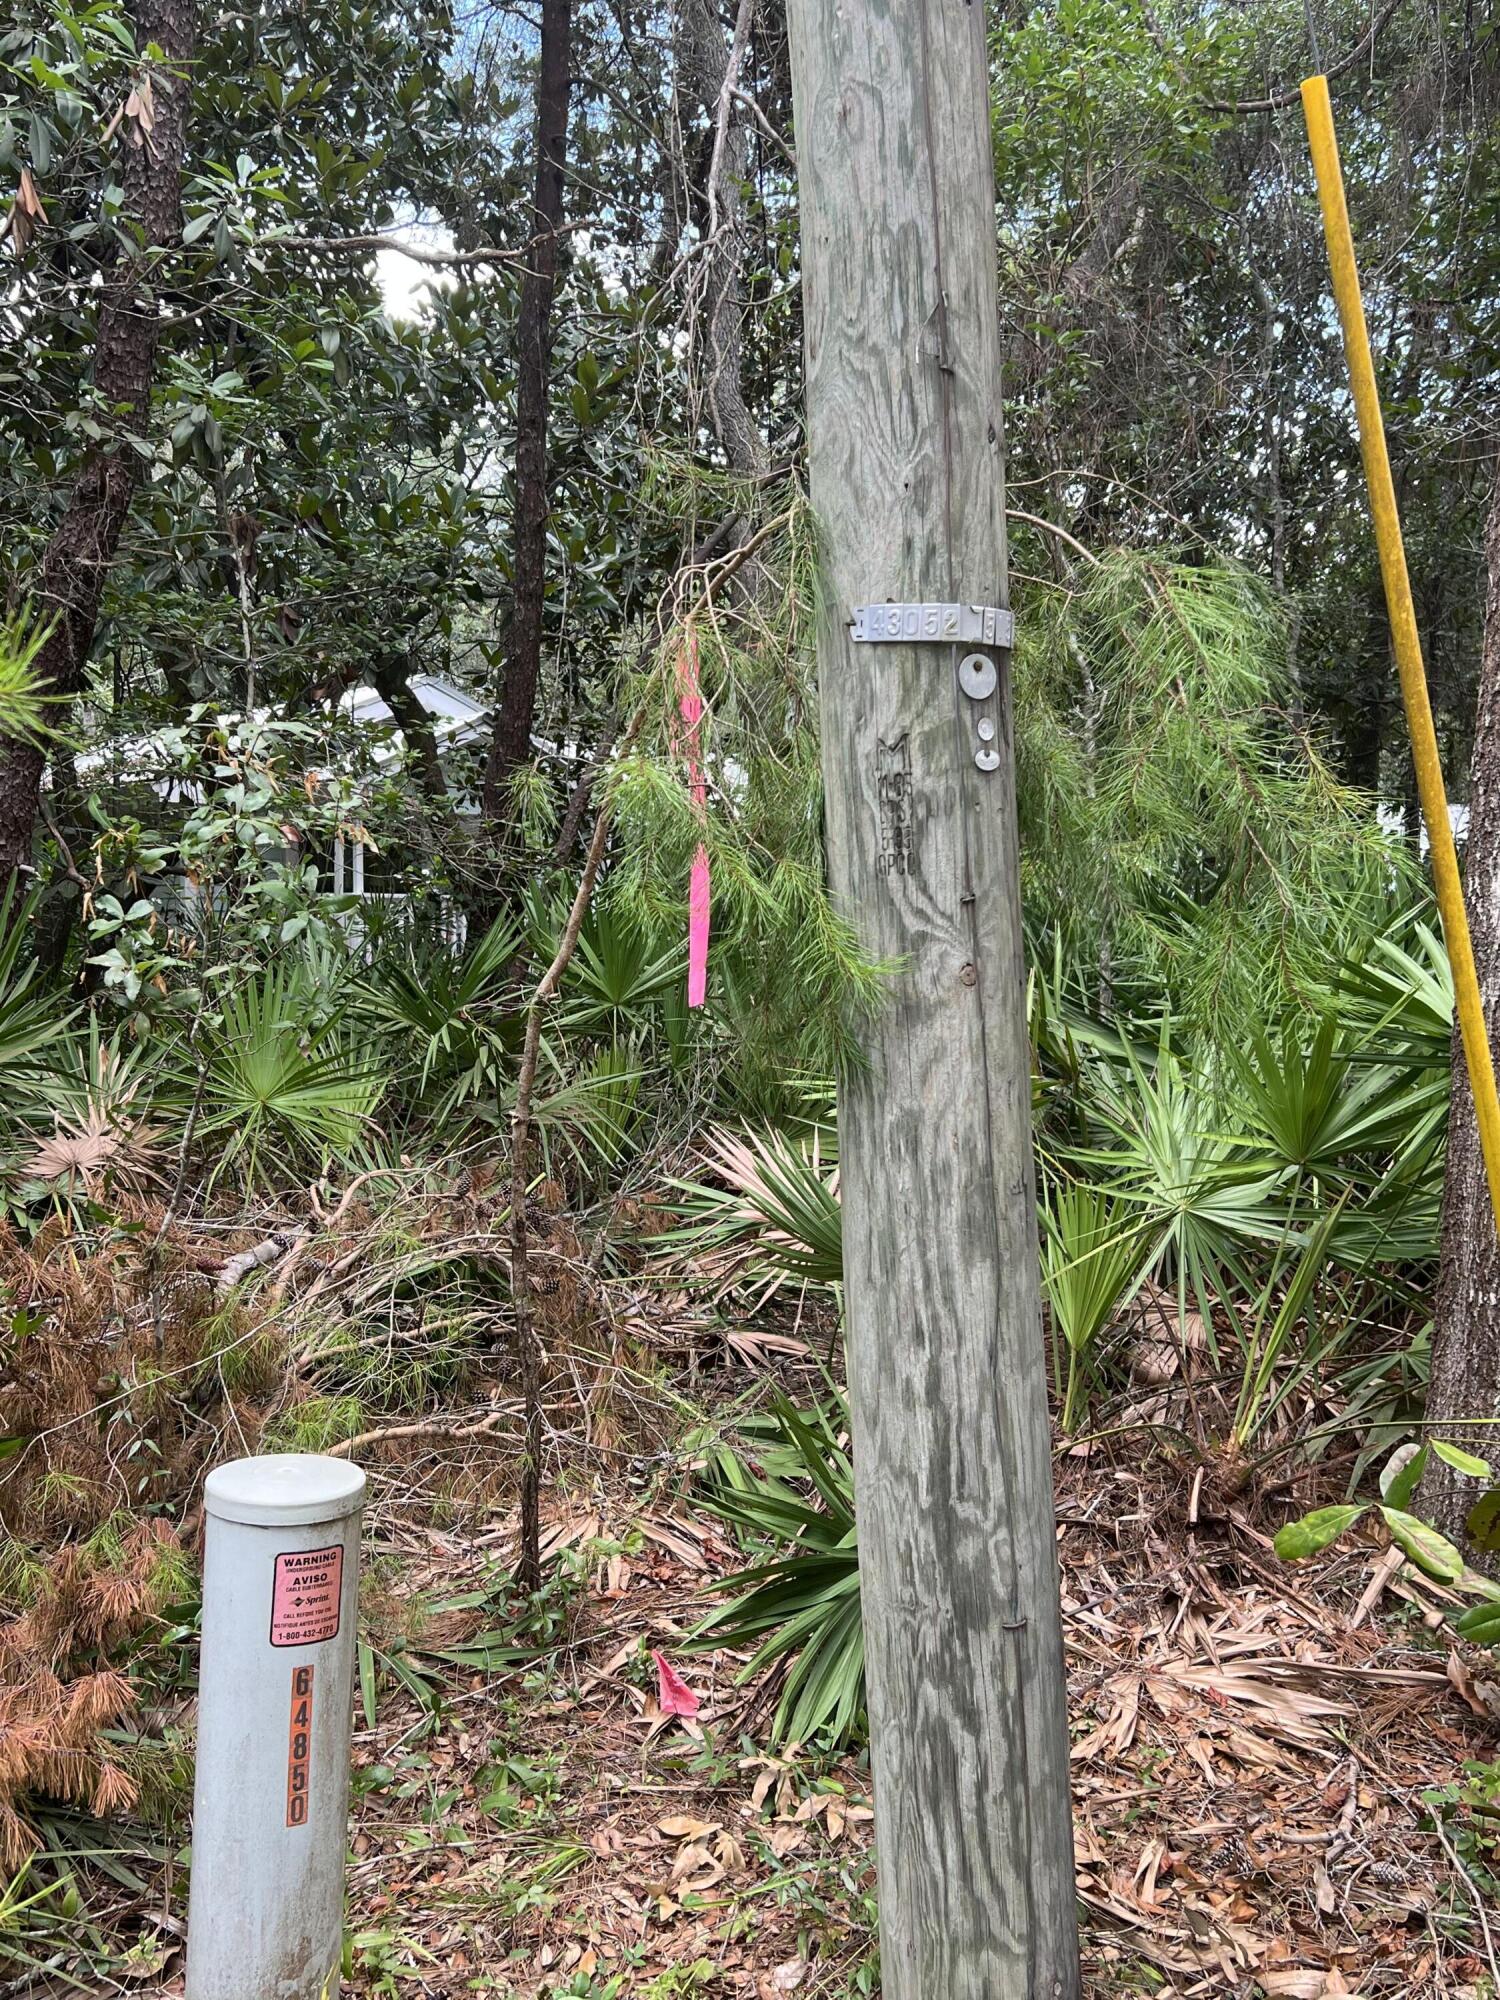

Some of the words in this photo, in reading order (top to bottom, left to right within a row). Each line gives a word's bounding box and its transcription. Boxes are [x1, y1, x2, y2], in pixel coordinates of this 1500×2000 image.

[870, 608, 959, 636] 43052
[284, 1552, 336, 1567] WARNING
[293, 1573, 327, 1585] AVISO
[305, 1594, 329, 1605] Sprint
[278, 1624, 334, 1640] 1-800-432-4770
[291, 1668, 310, 1823] 64850
